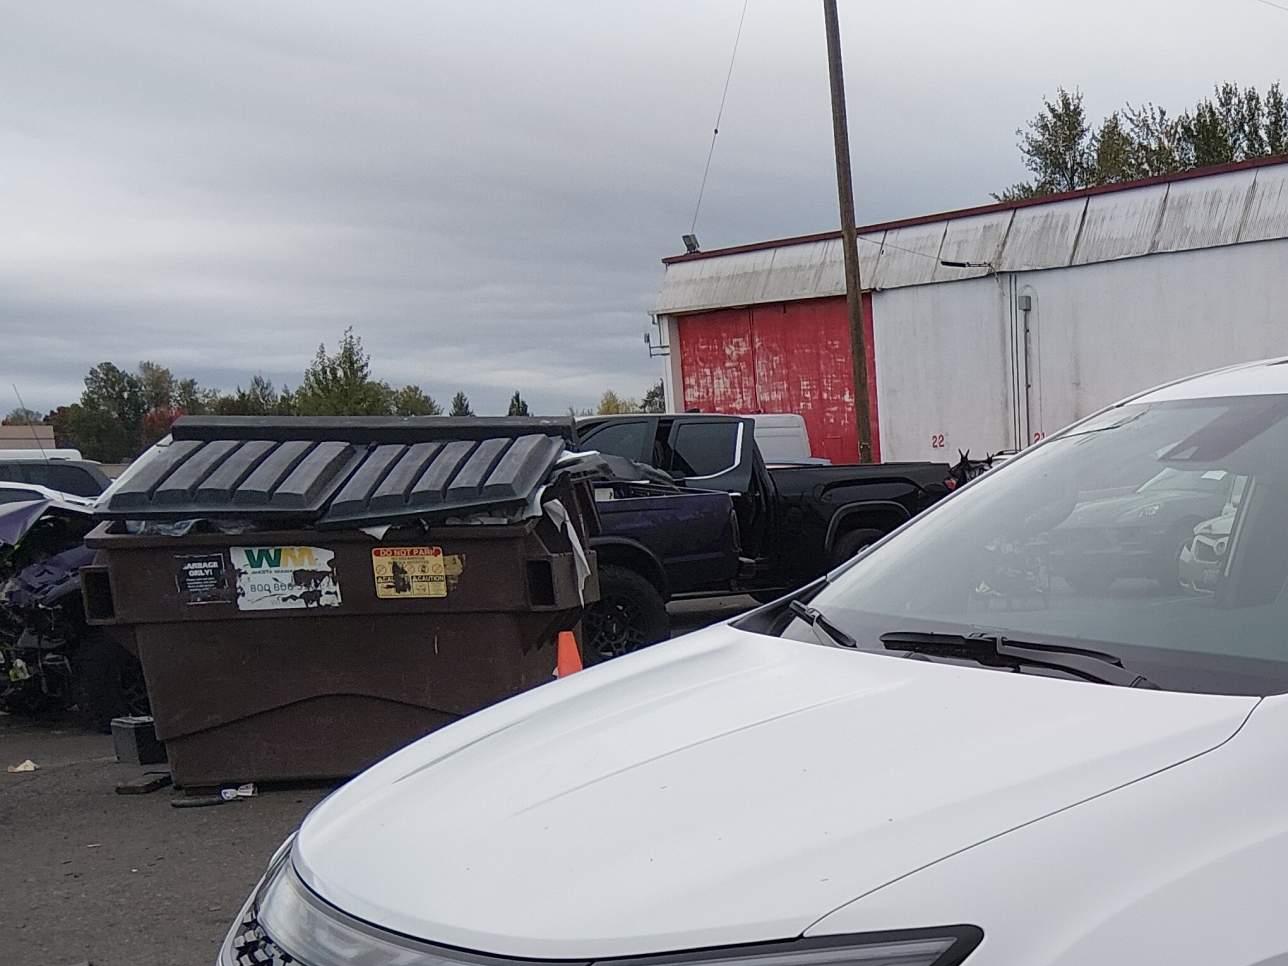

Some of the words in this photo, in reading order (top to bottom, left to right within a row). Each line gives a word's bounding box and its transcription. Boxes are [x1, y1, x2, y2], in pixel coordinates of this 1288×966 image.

[931, 434, 945, 448] 22
[244, 548, 316, 568] WM
[380, 549, 393, 557] DO
[393, 549, 411, 557] NOT
[250, 583, 271, 592] 800
